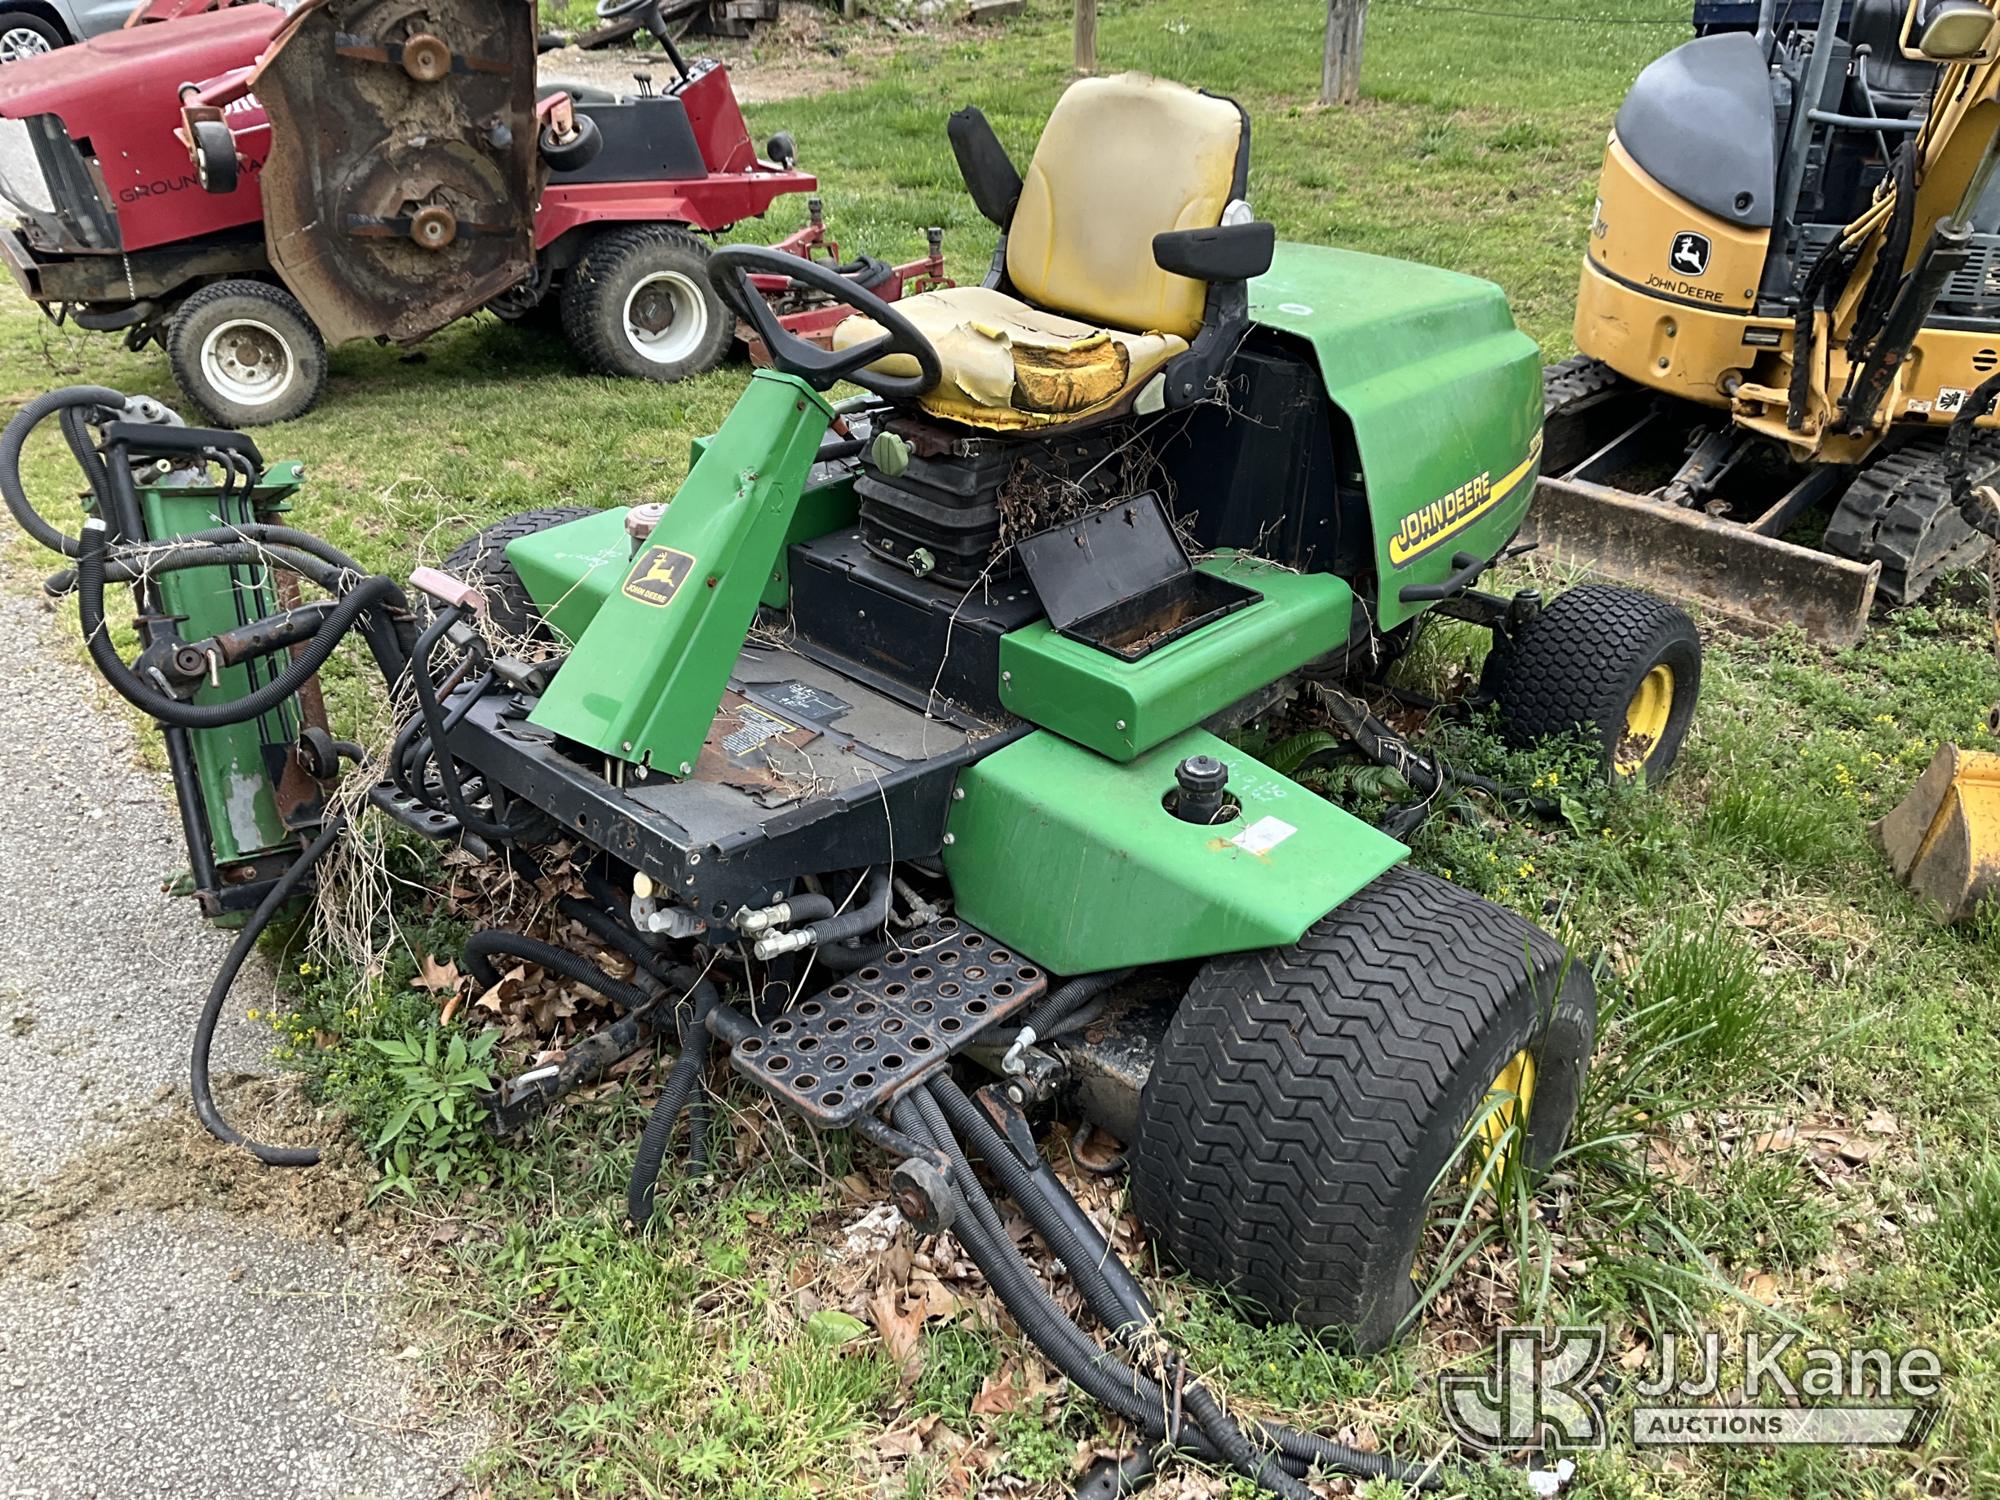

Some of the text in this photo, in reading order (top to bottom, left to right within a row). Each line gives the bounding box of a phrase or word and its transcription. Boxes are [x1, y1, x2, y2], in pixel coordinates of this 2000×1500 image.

[1645, 274, 1724, 303] JOHN DEERE
[1397, 470, 1491, 546] JOHN DEERE
[626, 584, 669, 603] JOHN DEERE
